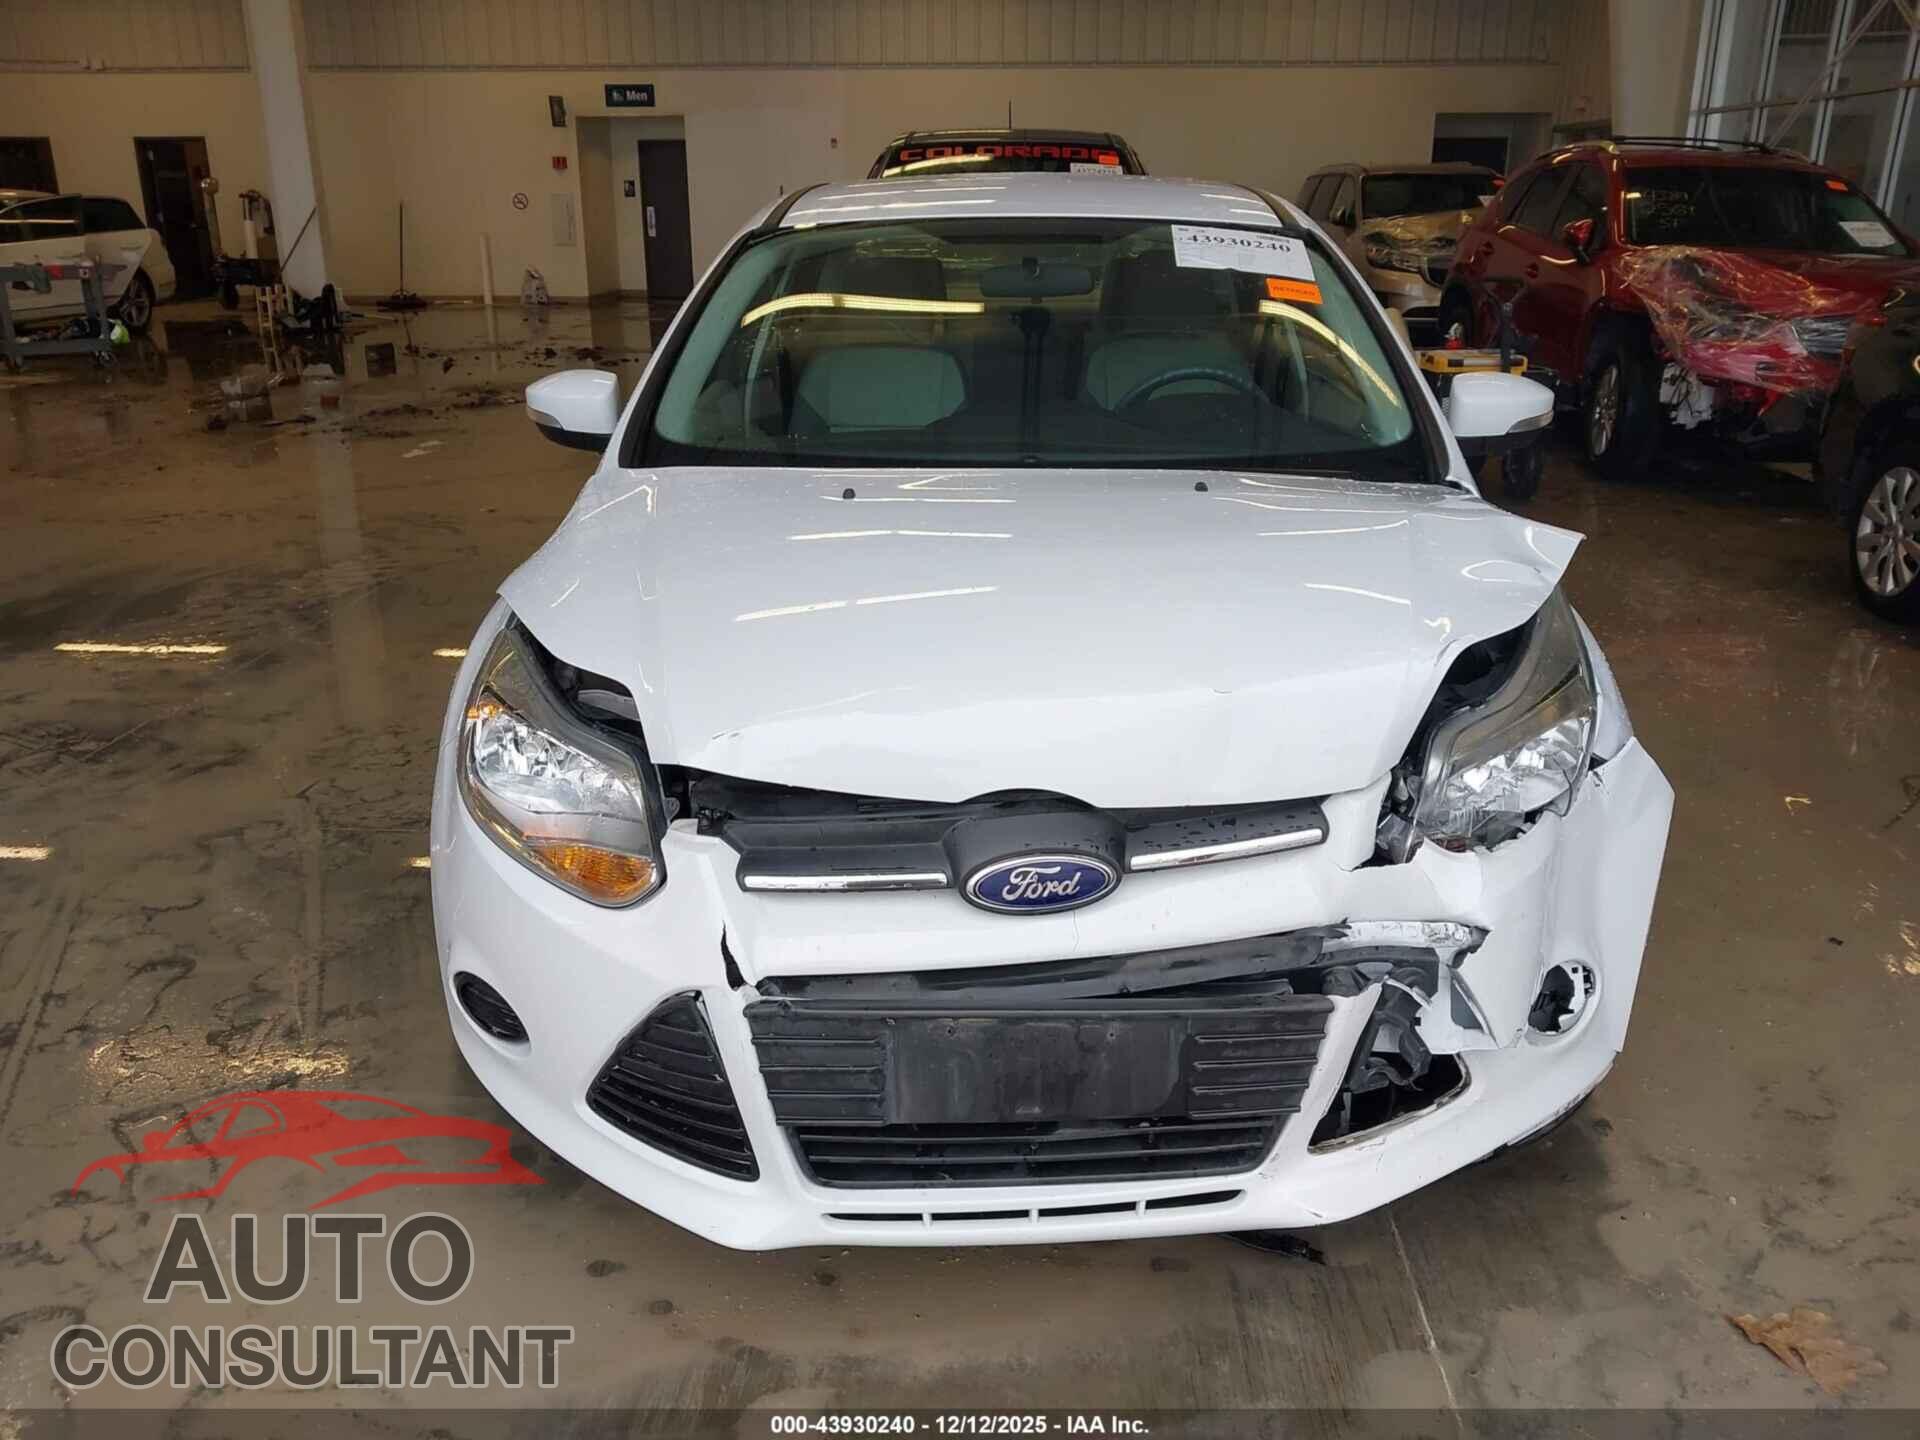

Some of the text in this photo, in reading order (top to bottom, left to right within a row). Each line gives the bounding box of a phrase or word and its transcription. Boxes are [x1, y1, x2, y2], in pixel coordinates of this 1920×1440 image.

[625, 89, 648, 102] Men
[1186, 234, 1292, 253] 43930240
[1001, 865, 1082, 901] Ford
